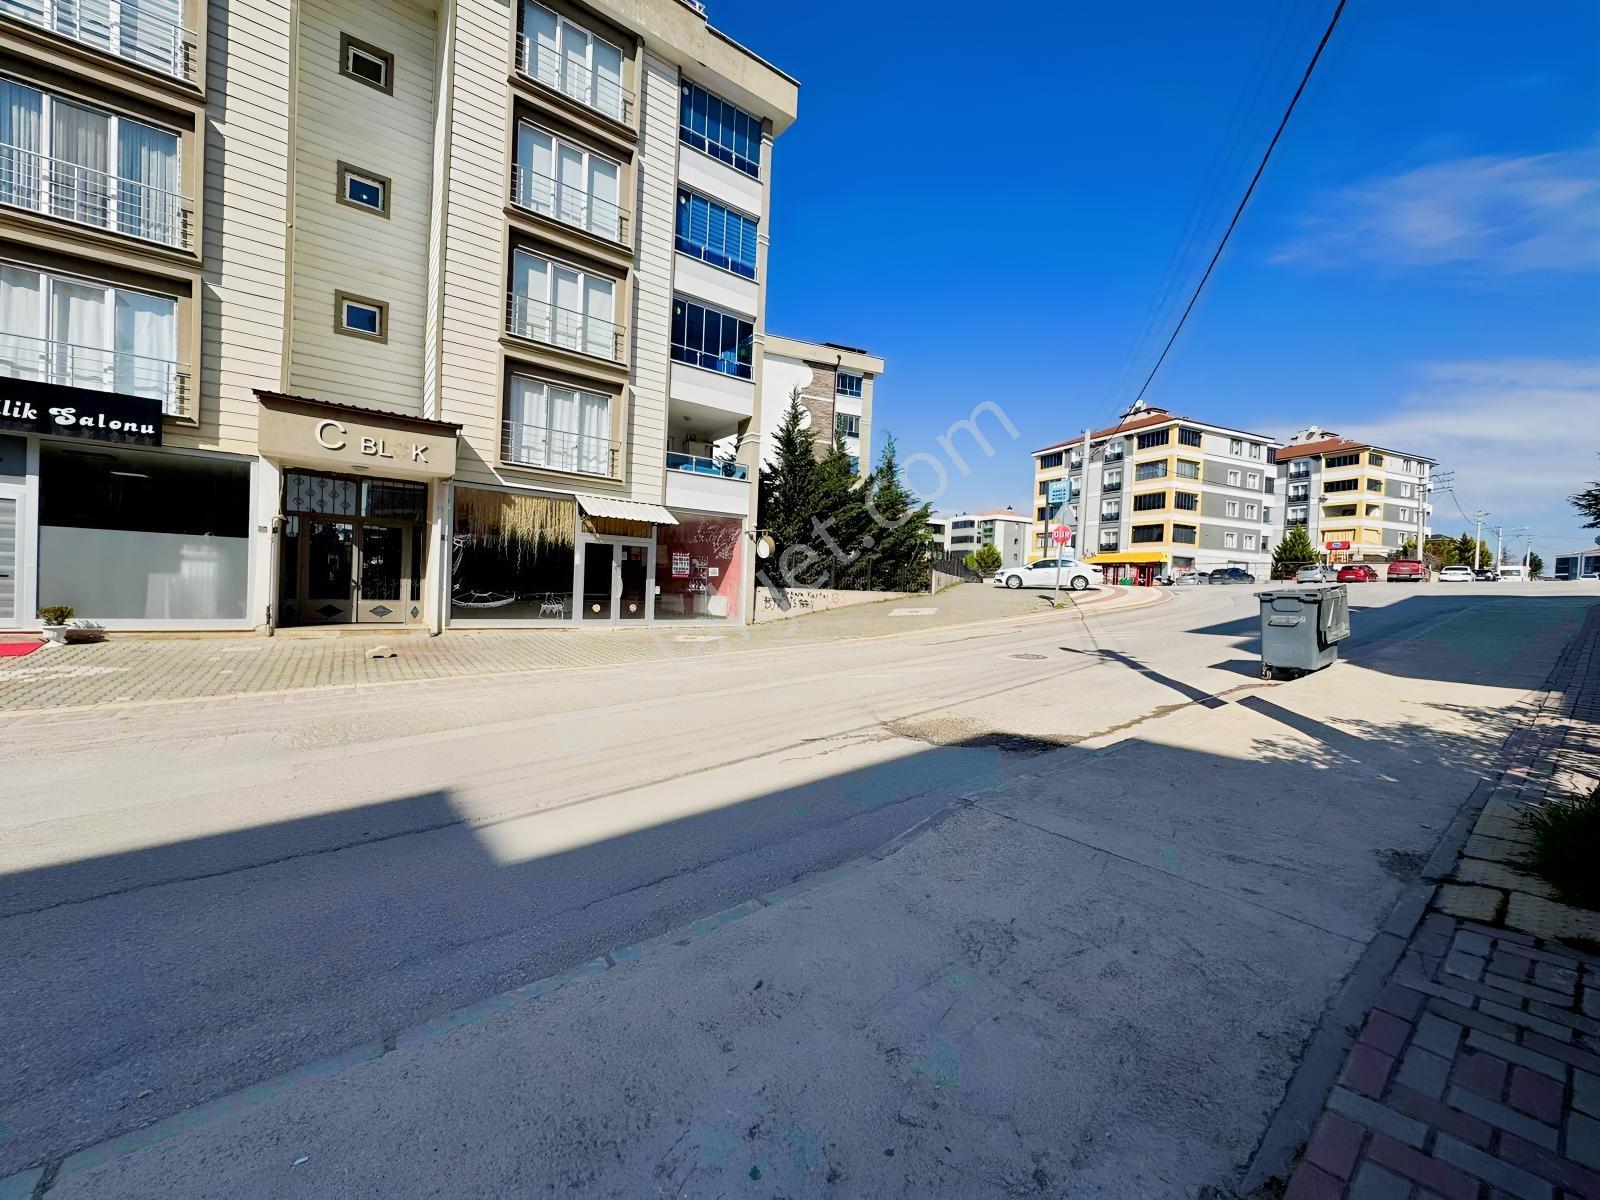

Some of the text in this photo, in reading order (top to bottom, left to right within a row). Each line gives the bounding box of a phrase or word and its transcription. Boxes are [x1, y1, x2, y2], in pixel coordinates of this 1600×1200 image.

[0, 399, 156, 434] lik Salonu
[315, 419, 429, 463] C BLK
